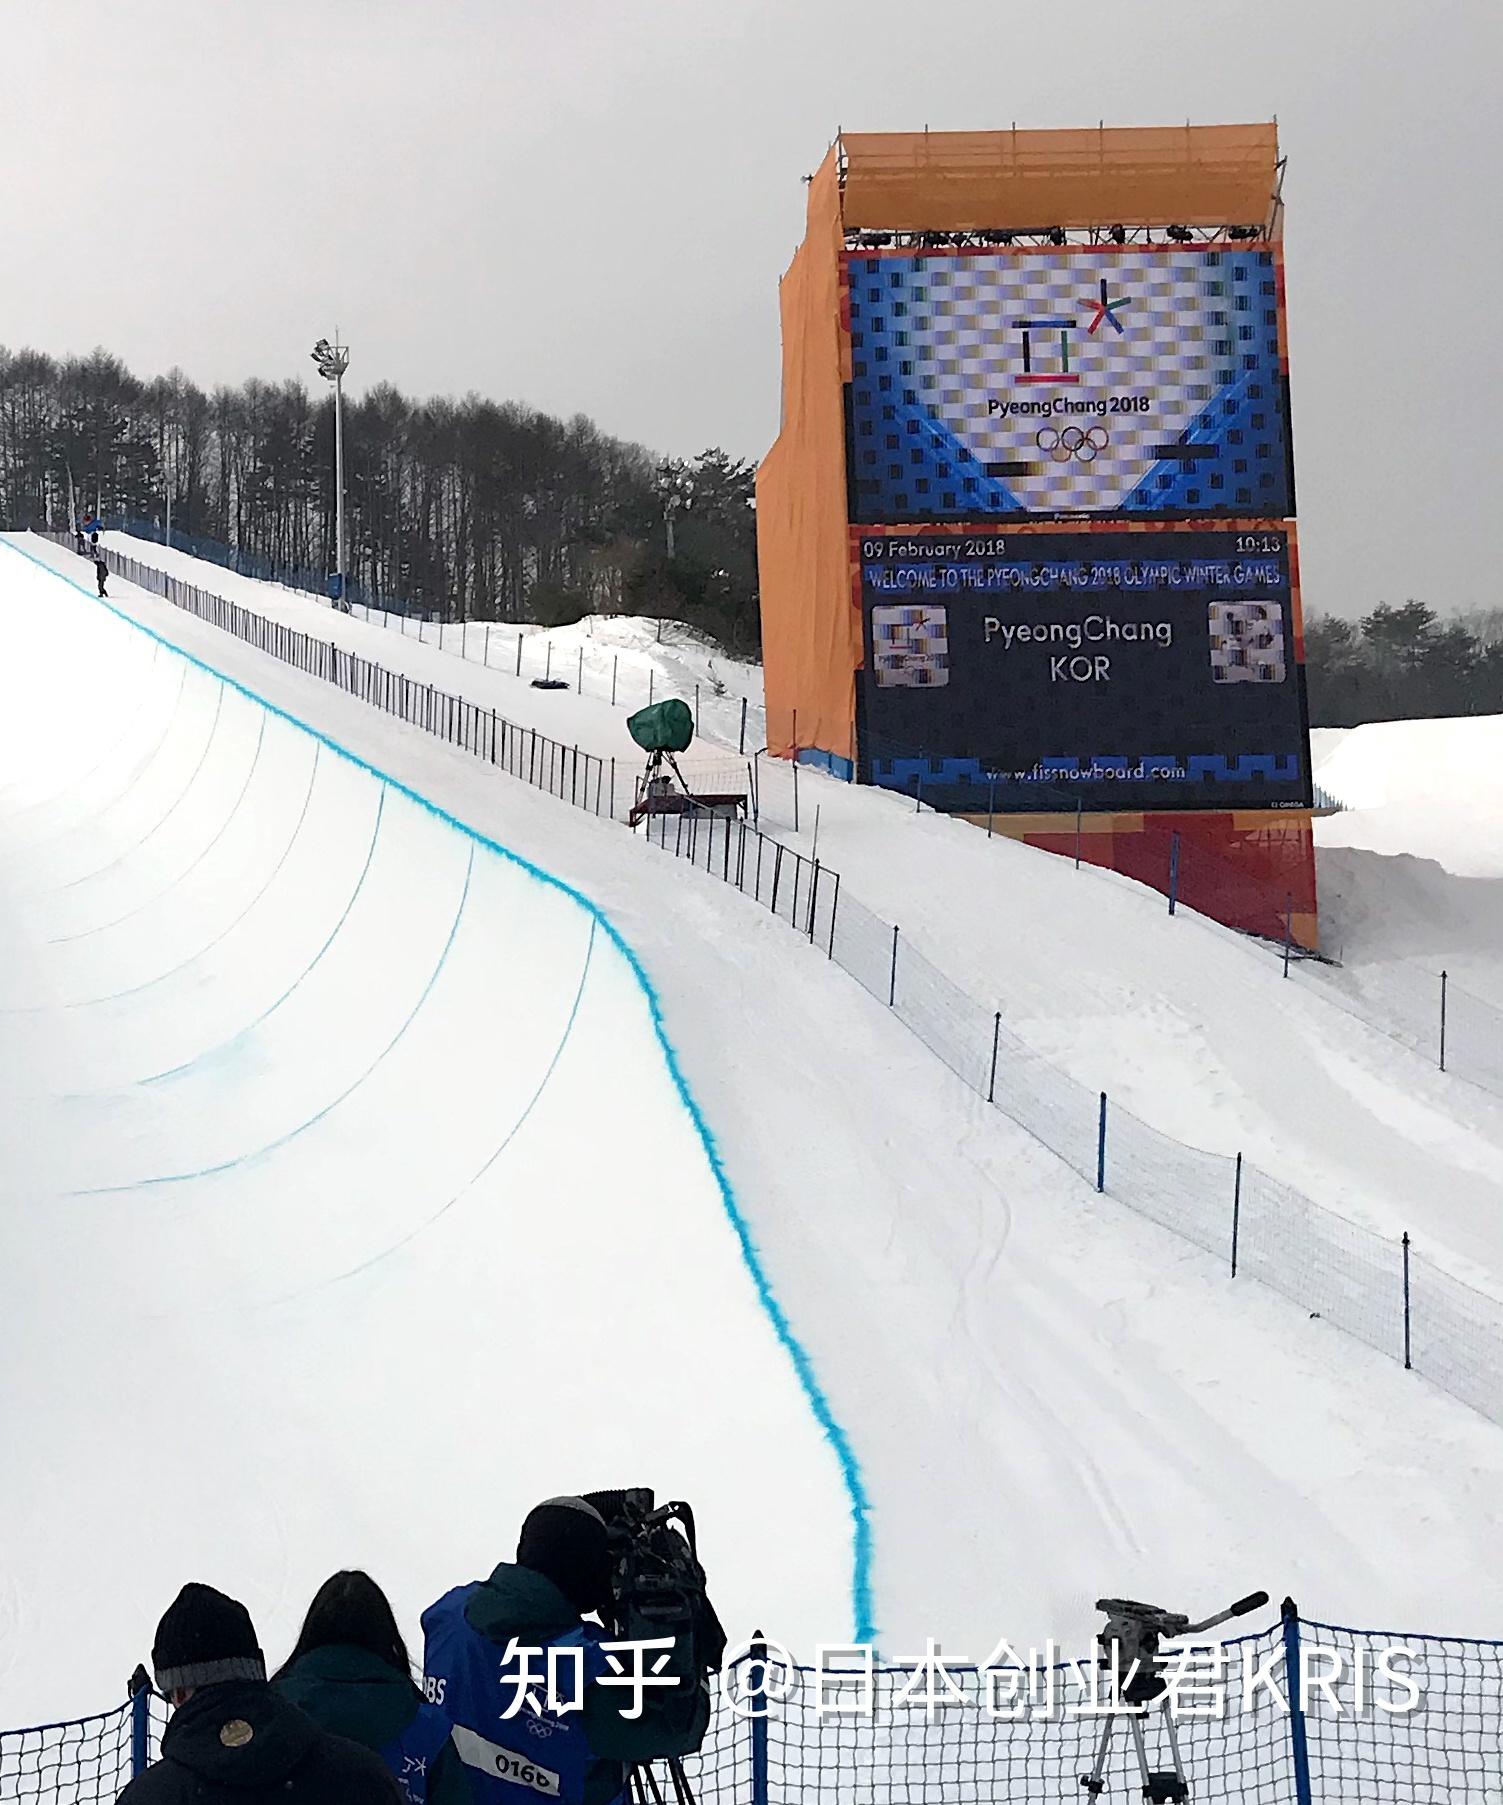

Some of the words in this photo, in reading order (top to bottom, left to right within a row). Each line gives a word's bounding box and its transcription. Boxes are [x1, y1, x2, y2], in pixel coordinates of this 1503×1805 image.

[988, 397, 1107, 419] PyeongChang
[1110, 396, 1151, 413] 2018
[863, 541, 884, 557] 09
[889, 541, 961, 560] February
[965, 540, 1005, 556] 2018
[1235, 536, 1281, 553] 10:13
[869, 569, 937, 589] WELCOME
[939, 568, 959, 588] TO
[961, 568, 985, 588] THE
[987, 567, 1089, 588] PYEONGCHANG
[1090, 567, 1121, 586] 2018
[1124, 566, 1182, 586] OLYMPIC
[1182, 565, 1231, 585] WINTER
[1233, 565, 1281, 584] GAMES
[984, 615, 1172, 650] PyeongChang
[1050, 655, 1111, 682] KOR
[986, 762, 1186, 781] www.fissnowboard.com
